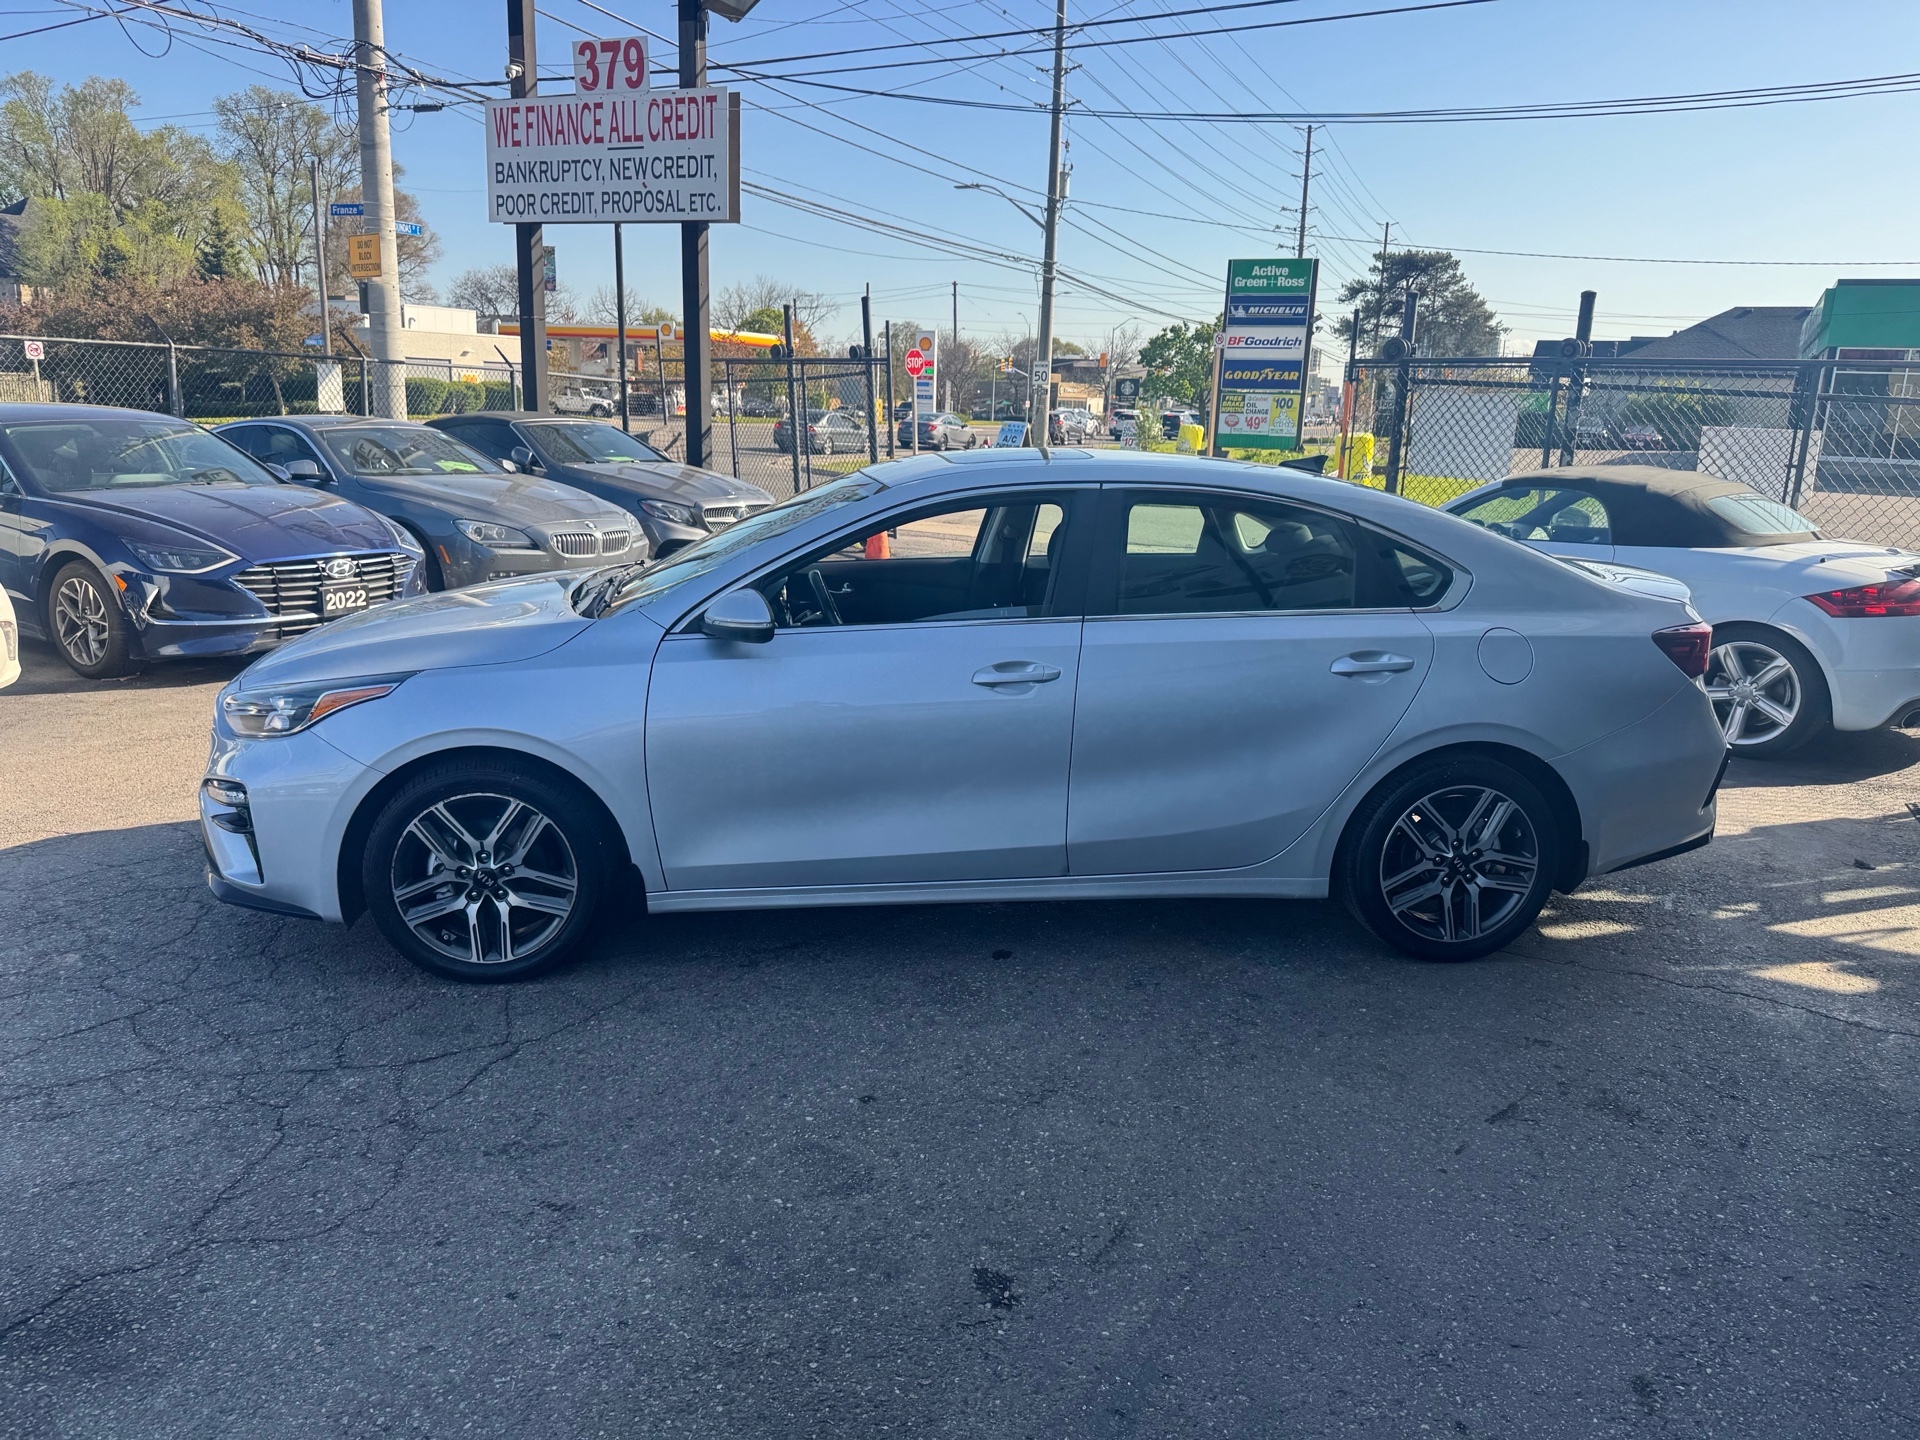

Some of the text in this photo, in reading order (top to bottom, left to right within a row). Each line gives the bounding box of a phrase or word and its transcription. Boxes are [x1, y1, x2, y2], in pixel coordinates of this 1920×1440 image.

[577, 38, 645, 91] 379
[493, 94, 718, 148] WE FINANCE ALL CREDIT
[495, 154, 718, 185] BANKRUPTCY, NEW CREDIT,
[332, 205, 358, 215] Franze
[496, 194, 536, 216] POOR
[540, 191, 597, 217] CREDIT,
[689, 192, 721, 212] ETC.
[1251, 264, 1290, 276] Active
[1247, 306, 1306, 315] MICHELIN
[1227, 336, 1303, 347] BFGoodrich
[907, 357, 923, 369] STOP
[1034, 370, 1048, 382] 50
[1224, 368, 1300, 381] GOODYEAR
[1001, 434, 1018, 444] A/C
[326, 589, 367, 611] 2022
